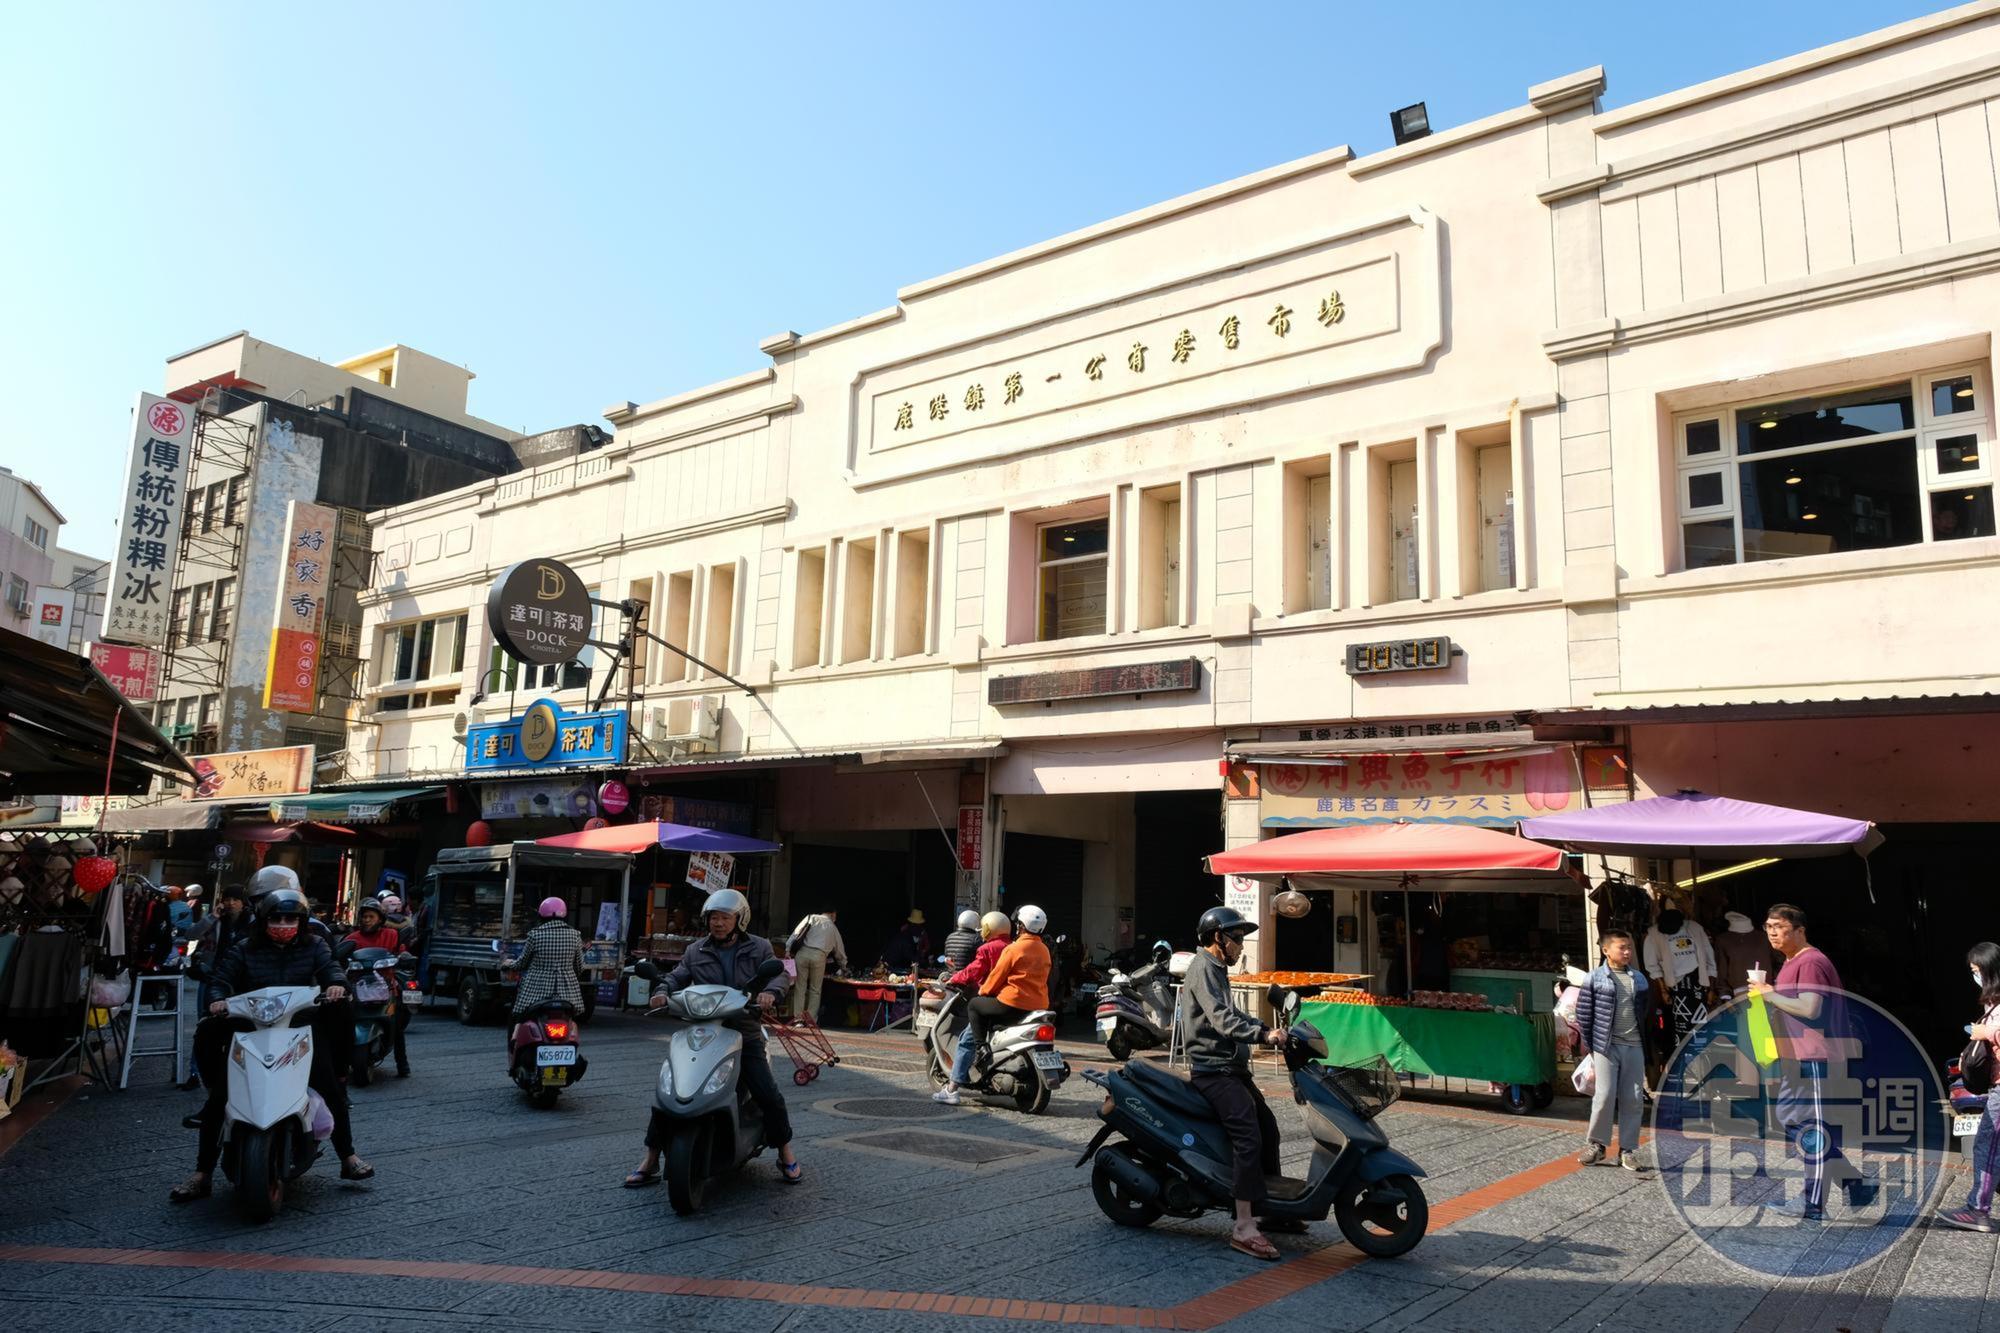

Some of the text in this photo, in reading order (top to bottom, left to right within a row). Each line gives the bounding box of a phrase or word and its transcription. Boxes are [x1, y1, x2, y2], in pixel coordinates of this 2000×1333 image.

[894, 290, 1347, 433] 鹿港鎮第一公有零售市場
[150, 404, 182, 435] 源
[120, 436, 181, 605] 傳統粉粿冰
[290, 527, 325, 618] 好家香
[526, 629, 568, 647] DOCK
[1317, 748, 1521, 792] 利興魚子行
[1316, 795, 1512, 813] 鹿港名產 カラスミ
[538, 1049, 574, 1060] NGS-8727
